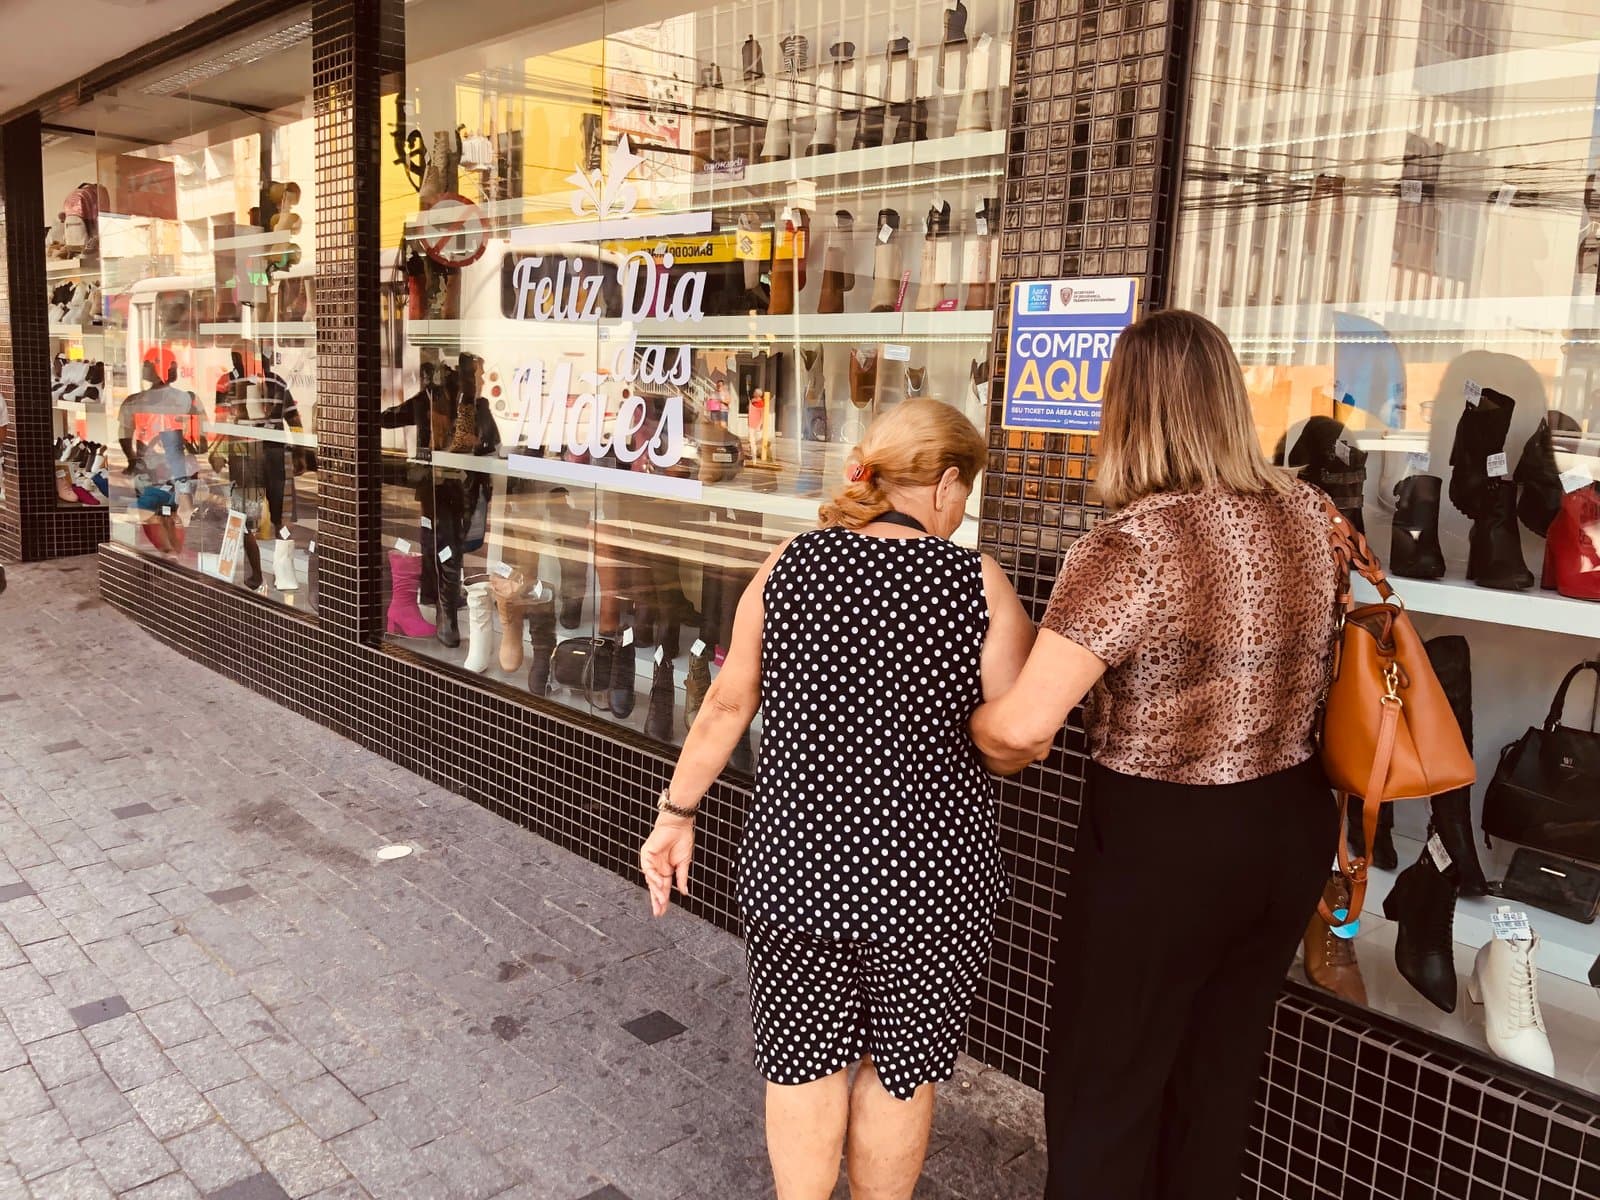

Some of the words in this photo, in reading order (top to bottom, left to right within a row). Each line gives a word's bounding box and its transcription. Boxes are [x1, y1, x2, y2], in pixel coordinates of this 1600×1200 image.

[512, 256, 605, 322] Feliz
[616, 251, 707, 323] Dia
[611, 330, 692, 386] das
[1012, 359, 1112, 402] AQU
[511, 359, 685, 468] Mães
[1024, 407, 1045, 415] TICKET
[1055, 407, 1073, 416] ÁREA
